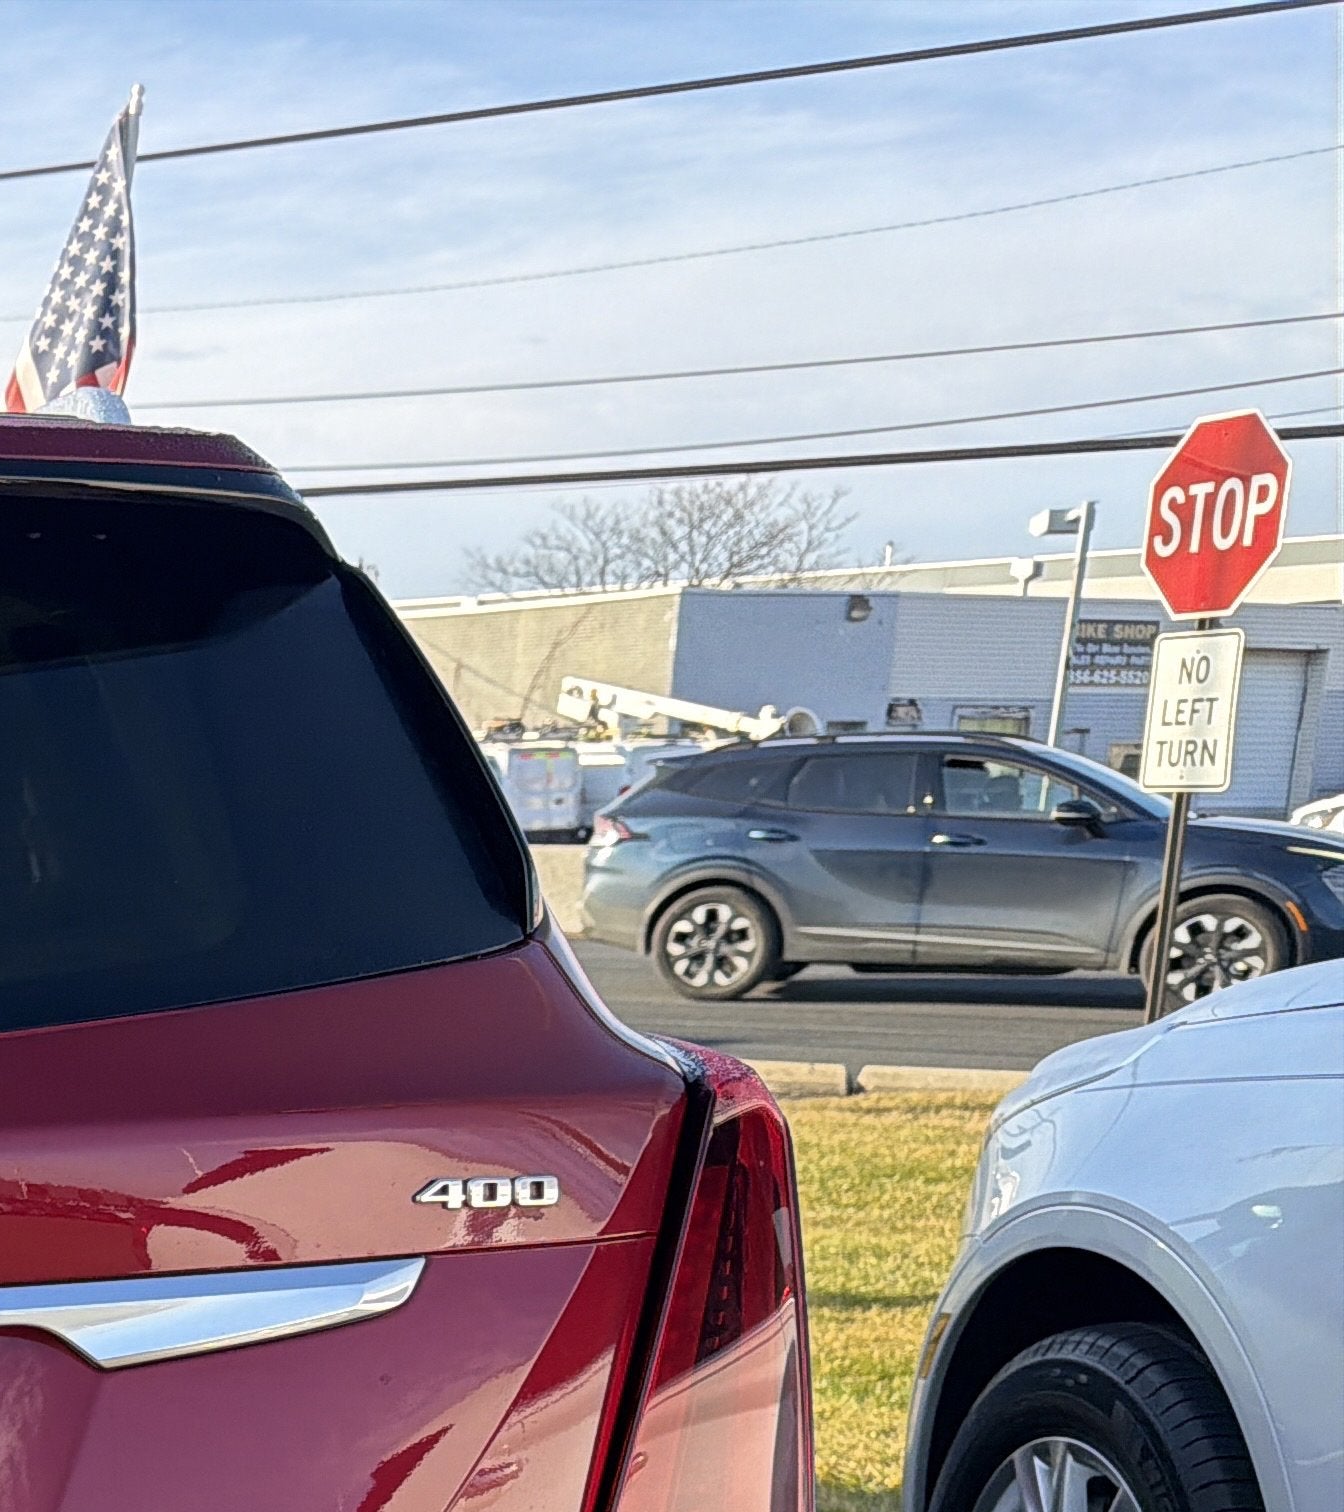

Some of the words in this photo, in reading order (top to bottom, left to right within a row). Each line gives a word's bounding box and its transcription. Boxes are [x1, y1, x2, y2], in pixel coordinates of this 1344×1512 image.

[1153, 472, 1279, 558] STOP
[1114, 623, 1157, 640] SHOP
[1179, 656, 1211, 684] NO
[1162, 697, 1219, 727] LEFT
[1156, 739, 1218, 768] TURN
[412, 1175, 560, 1210] 400
